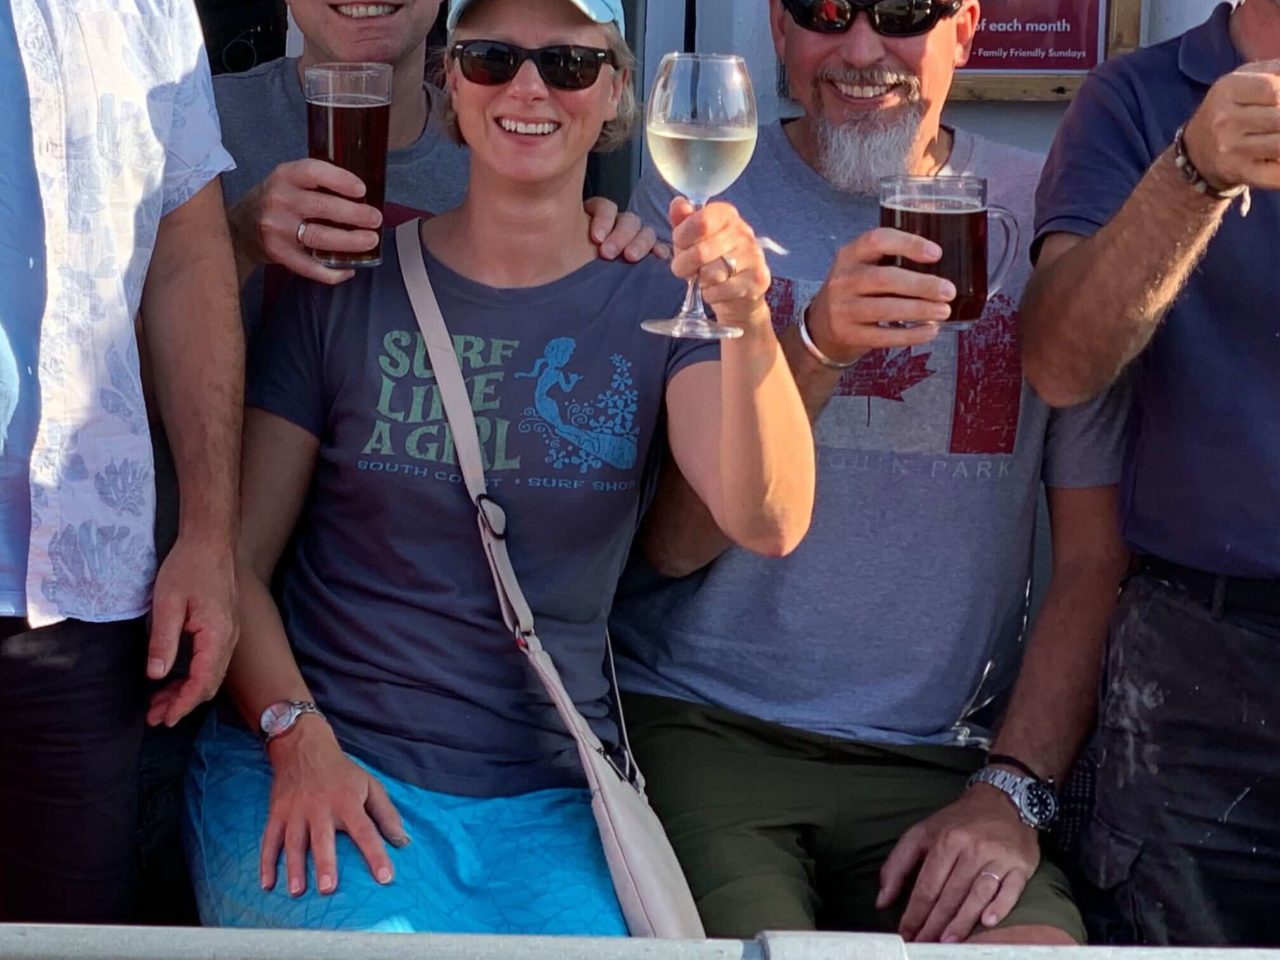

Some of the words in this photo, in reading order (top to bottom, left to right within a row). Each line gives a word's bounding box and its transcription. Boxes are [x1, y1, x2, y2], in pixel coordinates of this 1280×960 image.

[989, 18, 1022, 32] each
[1026, 18, 1071, 32] month
[978, 47, 1007, 59] Family
[1010, 47, 1046, 59] Friendly
[1048, 47, 1087, 59] Sundays
[360, 419, 395, 456] A
[357, 460, 428, 477] SOUTH
[527, 477, 585, 489] SURF
